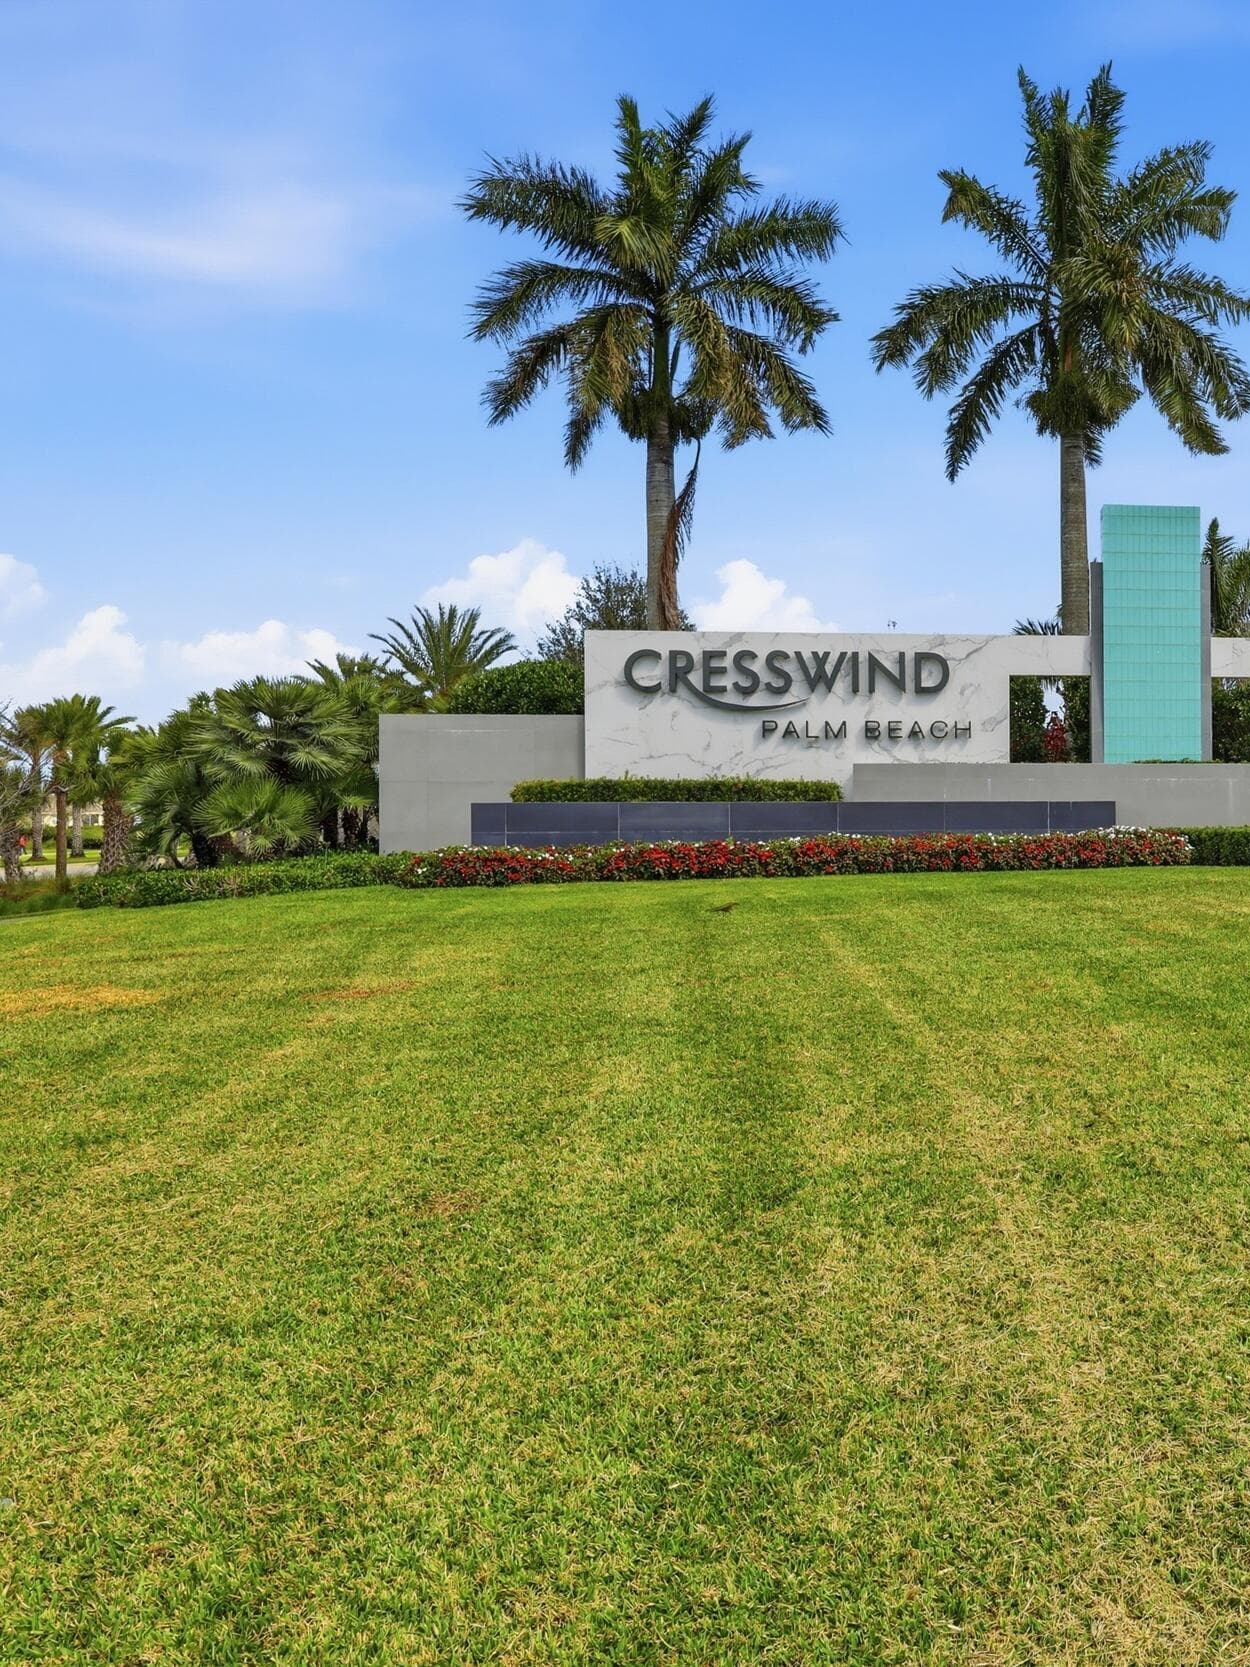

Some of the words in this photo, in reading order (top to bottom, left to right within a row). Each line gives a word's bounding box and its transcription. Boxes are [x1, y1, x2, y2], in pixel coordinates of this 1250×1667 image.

[624, 649, 950, 711] CRESSWIND
[761, 720, 847, 739] PALM
[865, 720, 972, 739] BEACH
